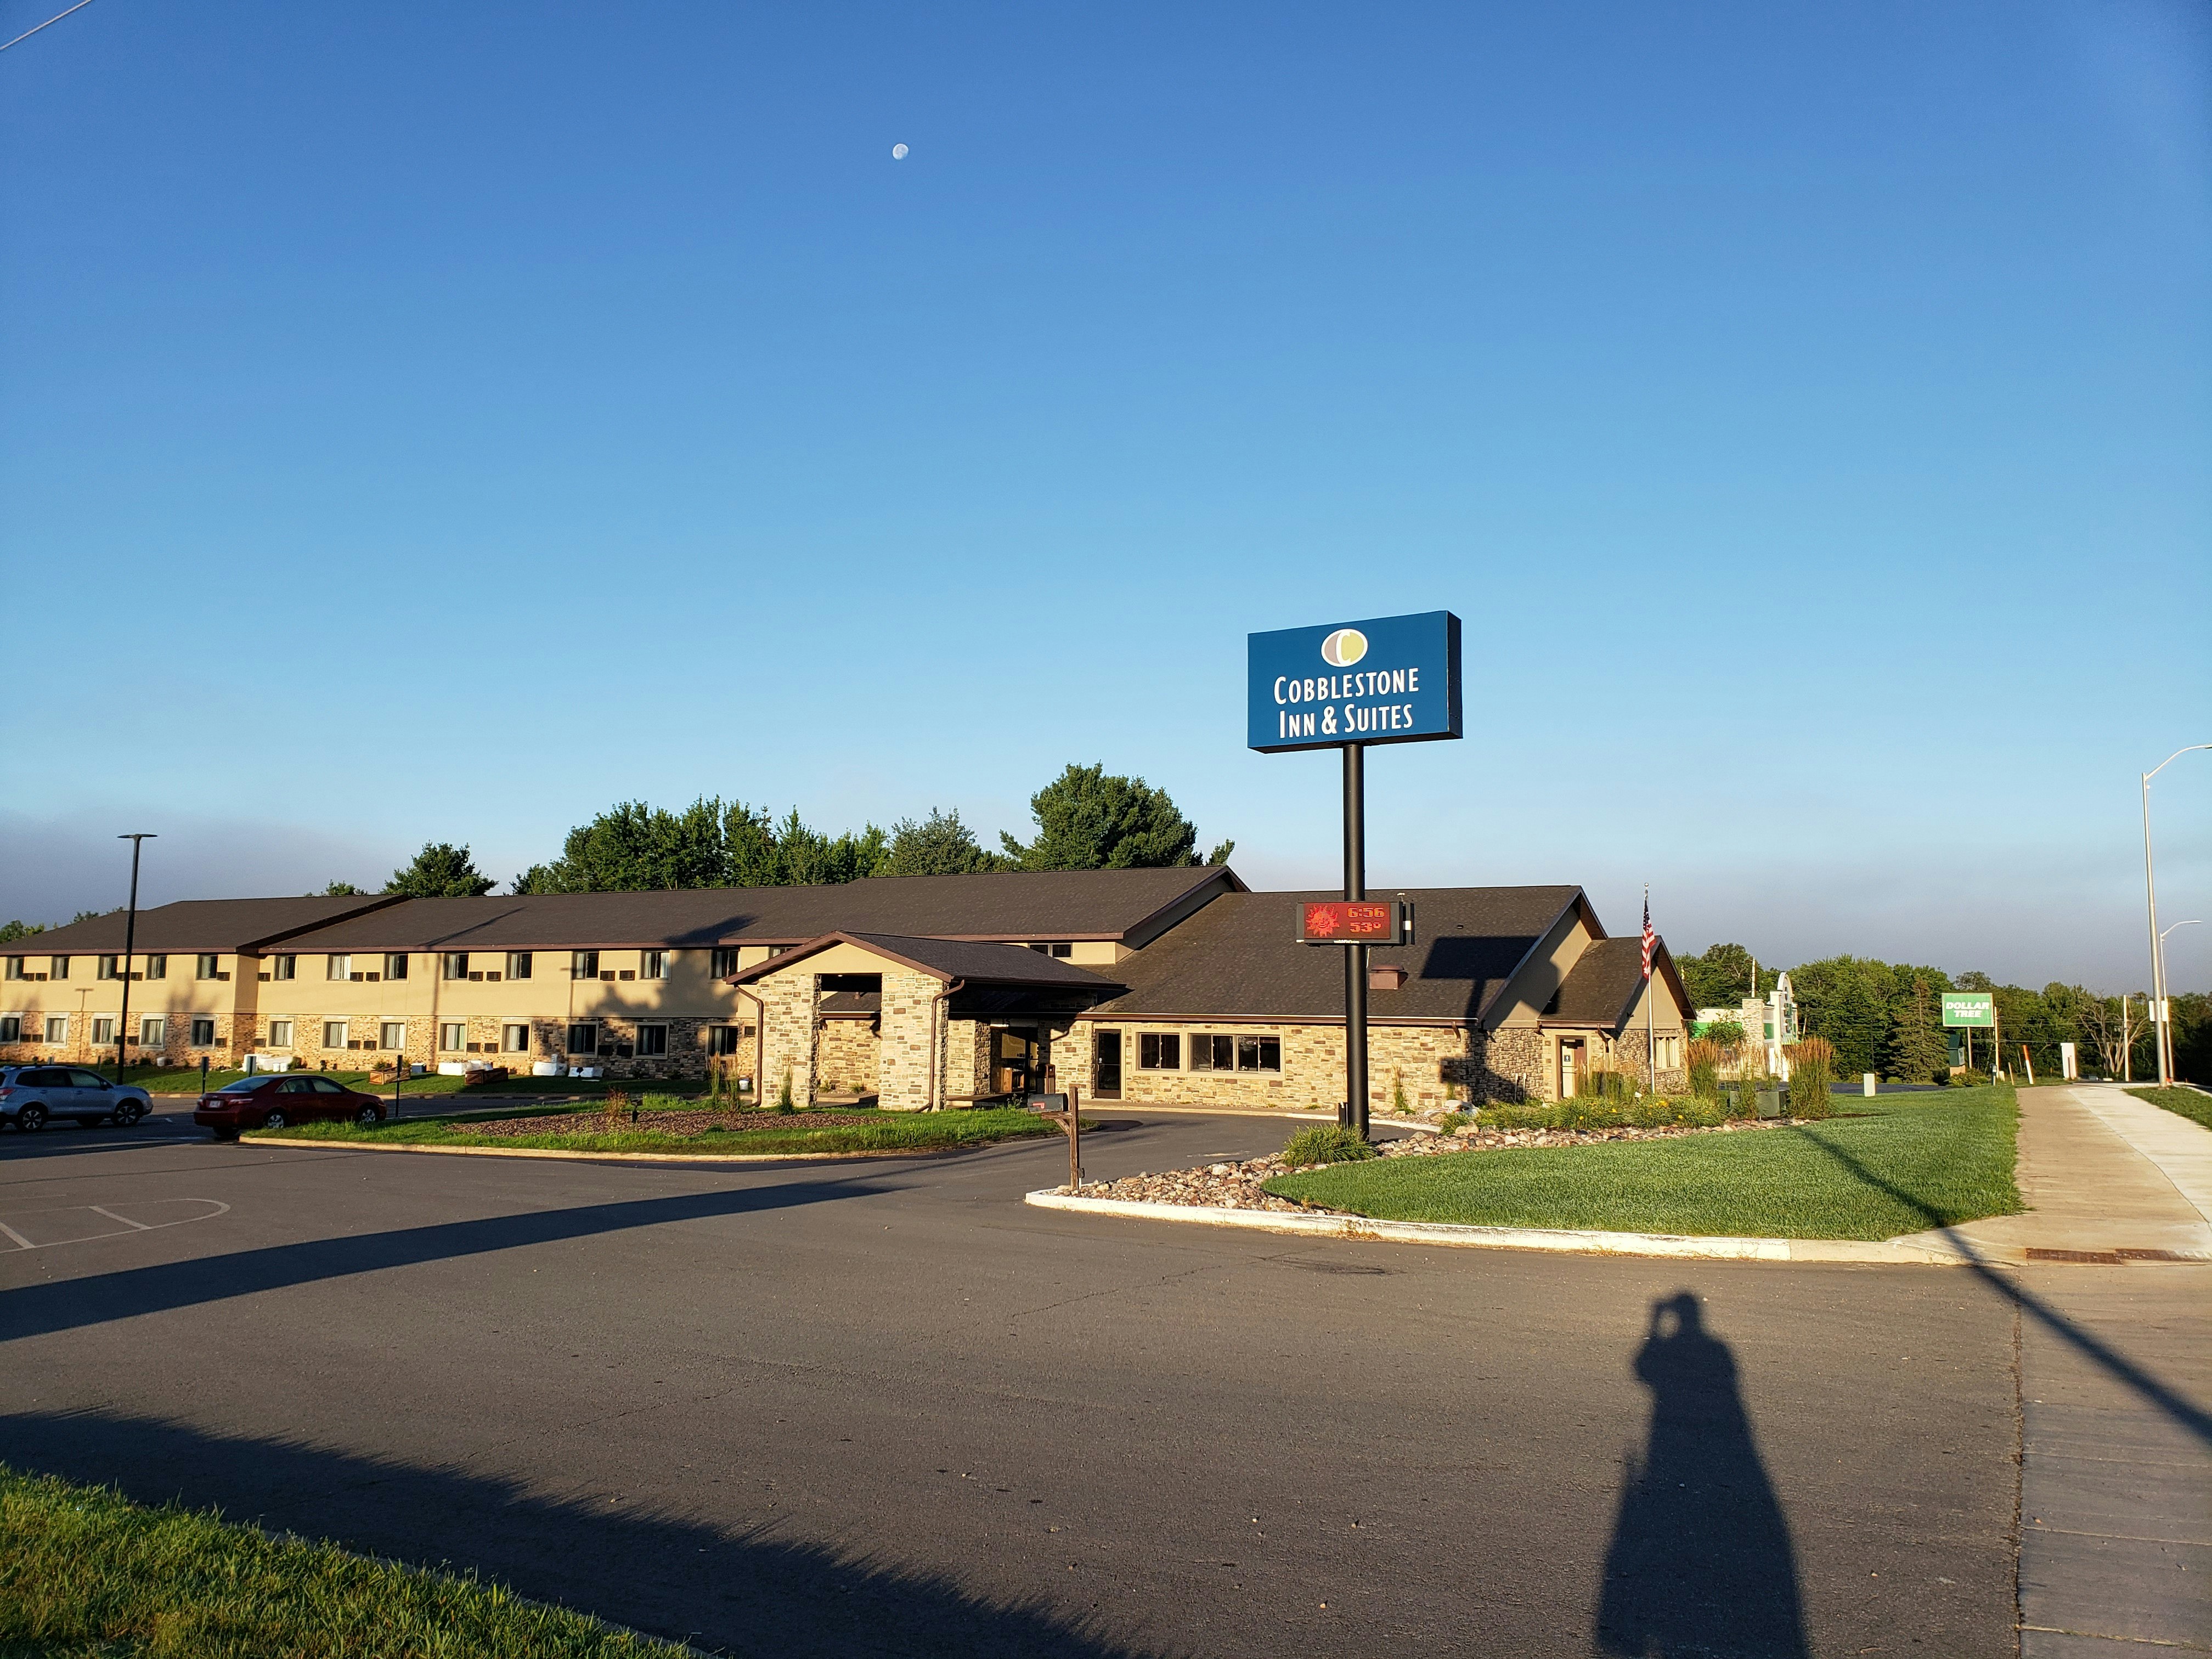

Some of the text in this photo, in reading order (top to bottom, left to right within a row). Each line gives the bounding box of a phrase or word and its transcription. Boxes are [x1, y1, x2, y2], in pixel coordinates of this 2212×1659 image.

[1274, 668, 1419, 705] COBBLESTONE
[1279, 703, 1413, 739] INN & SUITES
[1347, 907, 1385, 918] 6:56
[1945, 1002, 1990, 1010] DOLLAR
